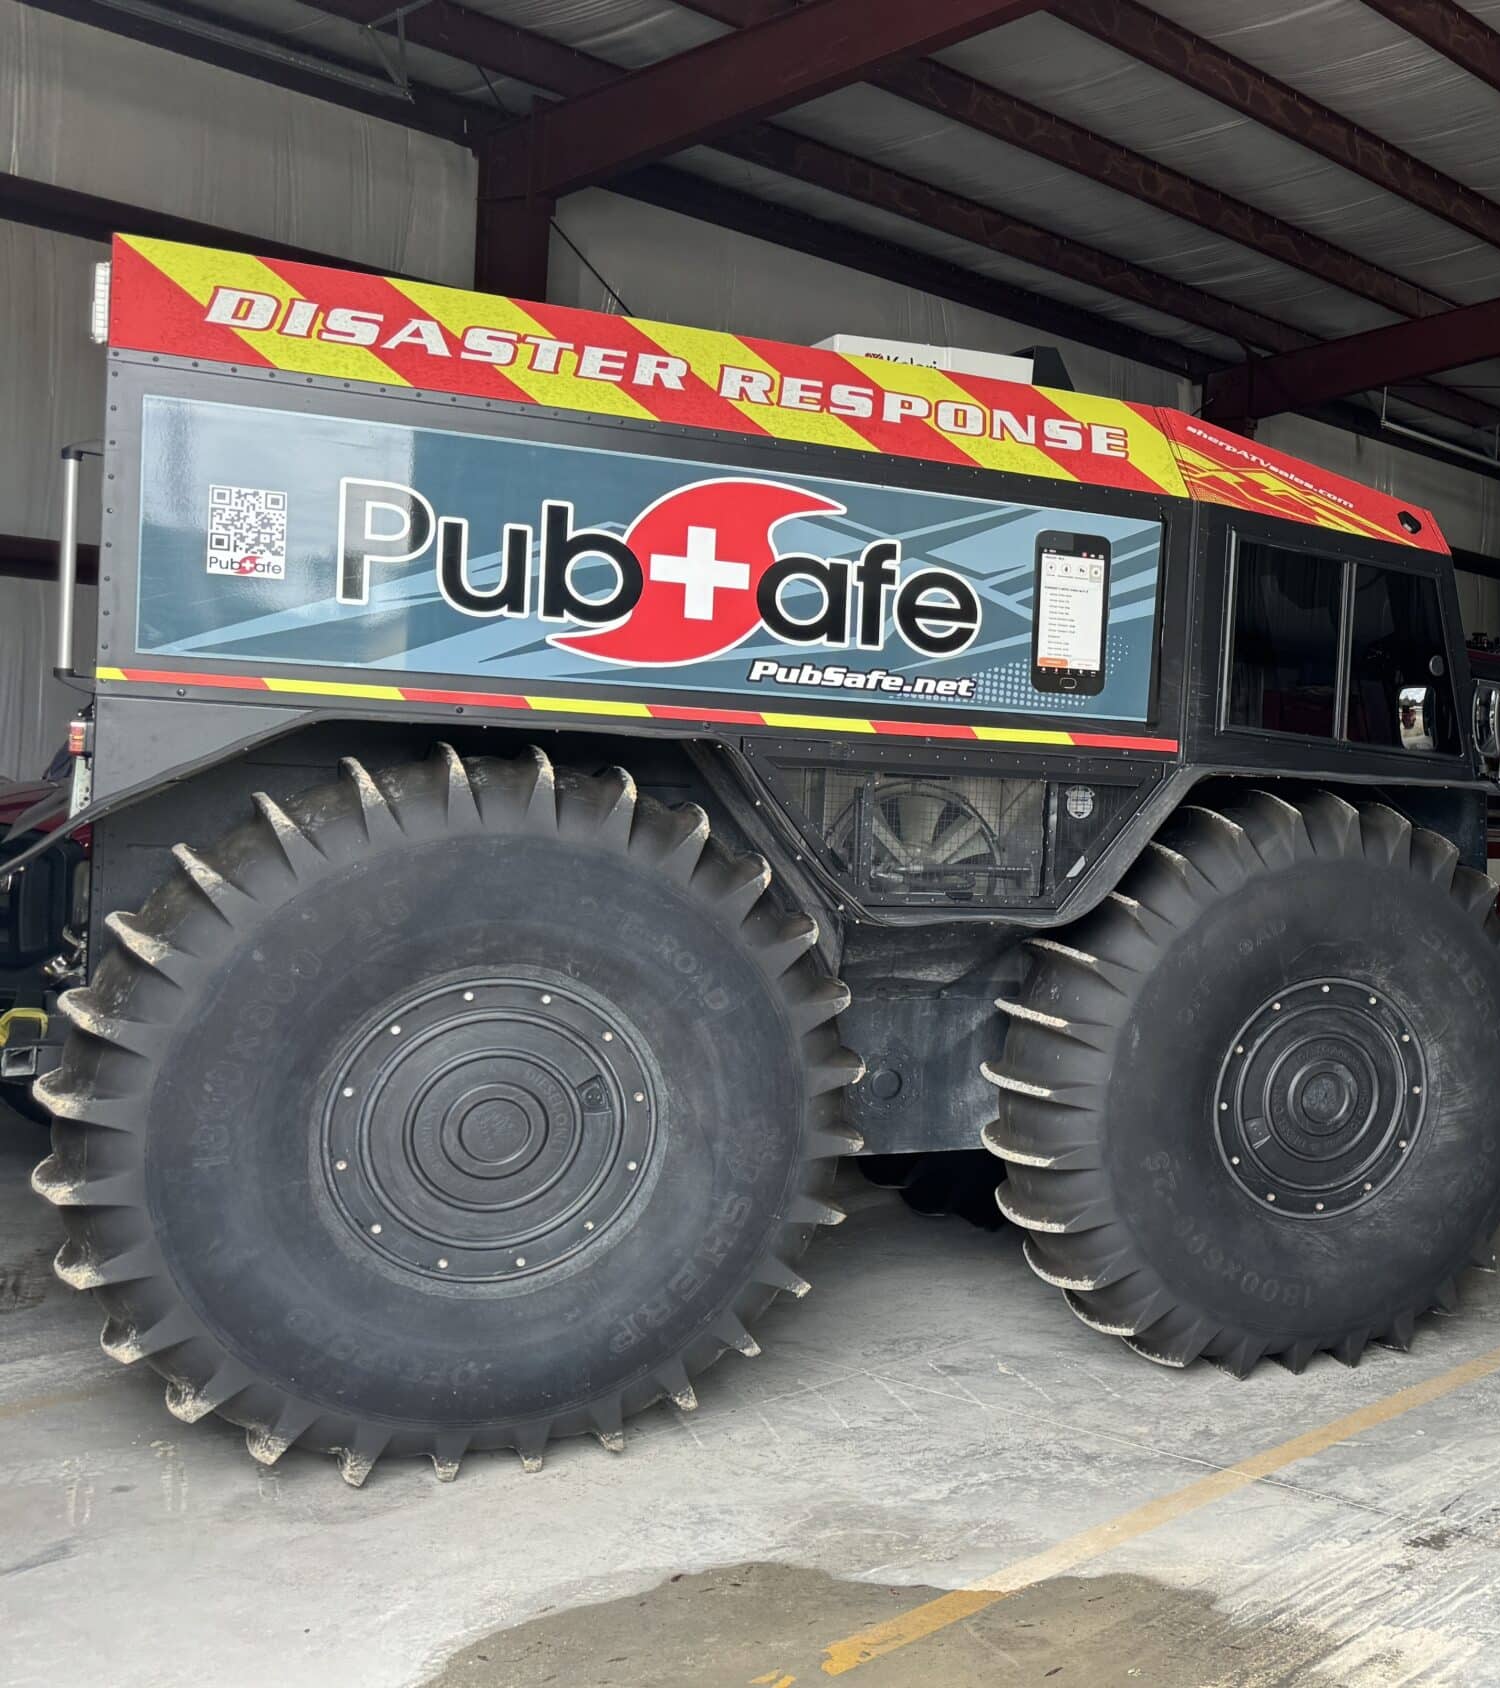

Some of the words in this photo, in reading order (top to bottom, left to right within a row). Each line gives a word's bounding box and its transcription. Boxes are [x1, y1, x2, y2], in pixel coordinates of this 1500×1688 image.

[204, 286, 690, 392] DISASTER
[719, 364, 1130, 459] RESPONSE
[1185, 424, 1355, 509] sherpATVsales.com
[748, 658, 978, 699] PubSafe.net
